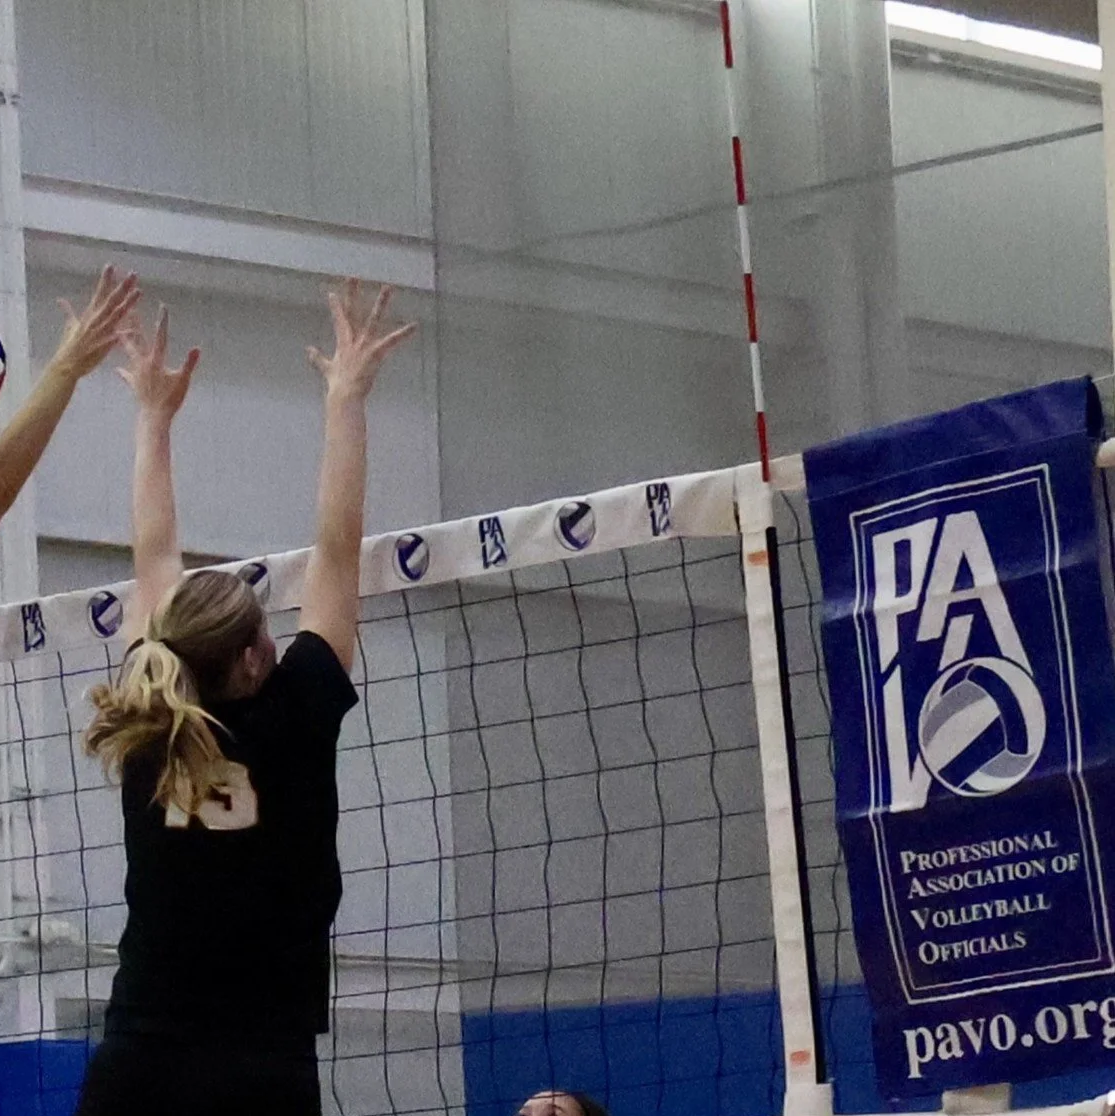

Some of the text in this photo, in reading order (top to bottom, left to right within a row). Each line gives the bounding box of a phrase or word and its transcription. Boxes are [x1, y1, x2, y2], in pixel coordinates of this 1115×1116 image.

[900, 831, 1058, 875] PROFESSIONAL
[907, 852, 1081, 899] ASSOCIATION OF
[910, 893, 1051, 931] VOLLEYBALL
[918, 931, 1028, 965] OFFICIALS
